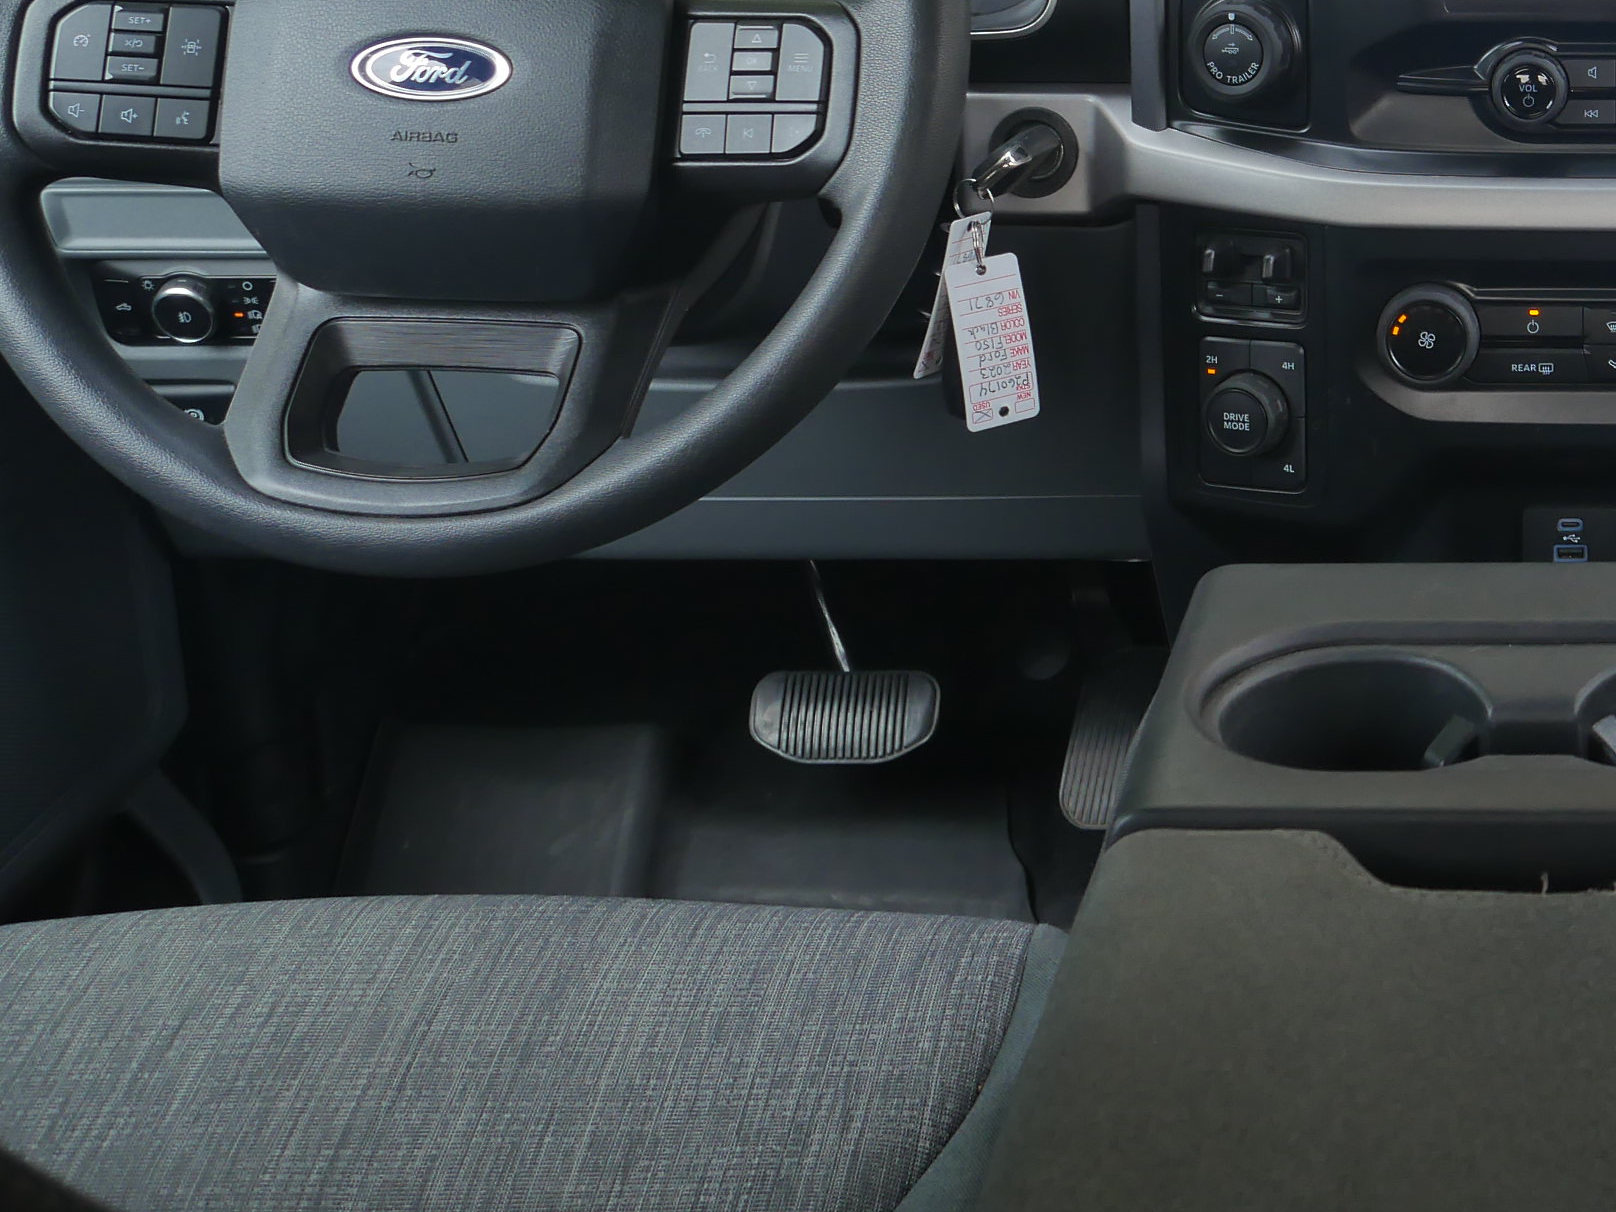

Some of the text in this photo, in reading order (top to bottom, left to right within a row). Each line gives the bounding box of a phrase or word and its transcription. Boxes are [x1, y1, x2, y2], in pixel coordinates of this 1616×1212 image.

[389, 48, 472, 84] Ford
[788, 64, 813, 73] MENU
[1207, 61, 1259, 84] PRO TRAILER
[1519, 84, 1538, 92] VOL
[390, 130, 458, 143] AIRBAG
[969, 290, 1021, 311] VIN 6871
[998, 302, 1022, 317] SERIES
[967, 317, 1025, 339] COLOR Black
[975, 331, 1027, 351] MODEL F150
[979, 345, 1029, 367] MAKE Ford
[1206, 355, 1218, 364] 2H
[980, 359, 1031, 379] YEAR 2023
[1282, 362, 1295, 370] 4H
[1511, 364, 1537, 372] REAR
[1017, 391, 1031, 400] NEW
[973, 401, 991, 411] USED
[1223, 412, 1250, 422] DRIVE
[1223, 421, 1250, 431] MODE
[1283, 464, 1295, 473] 4L
